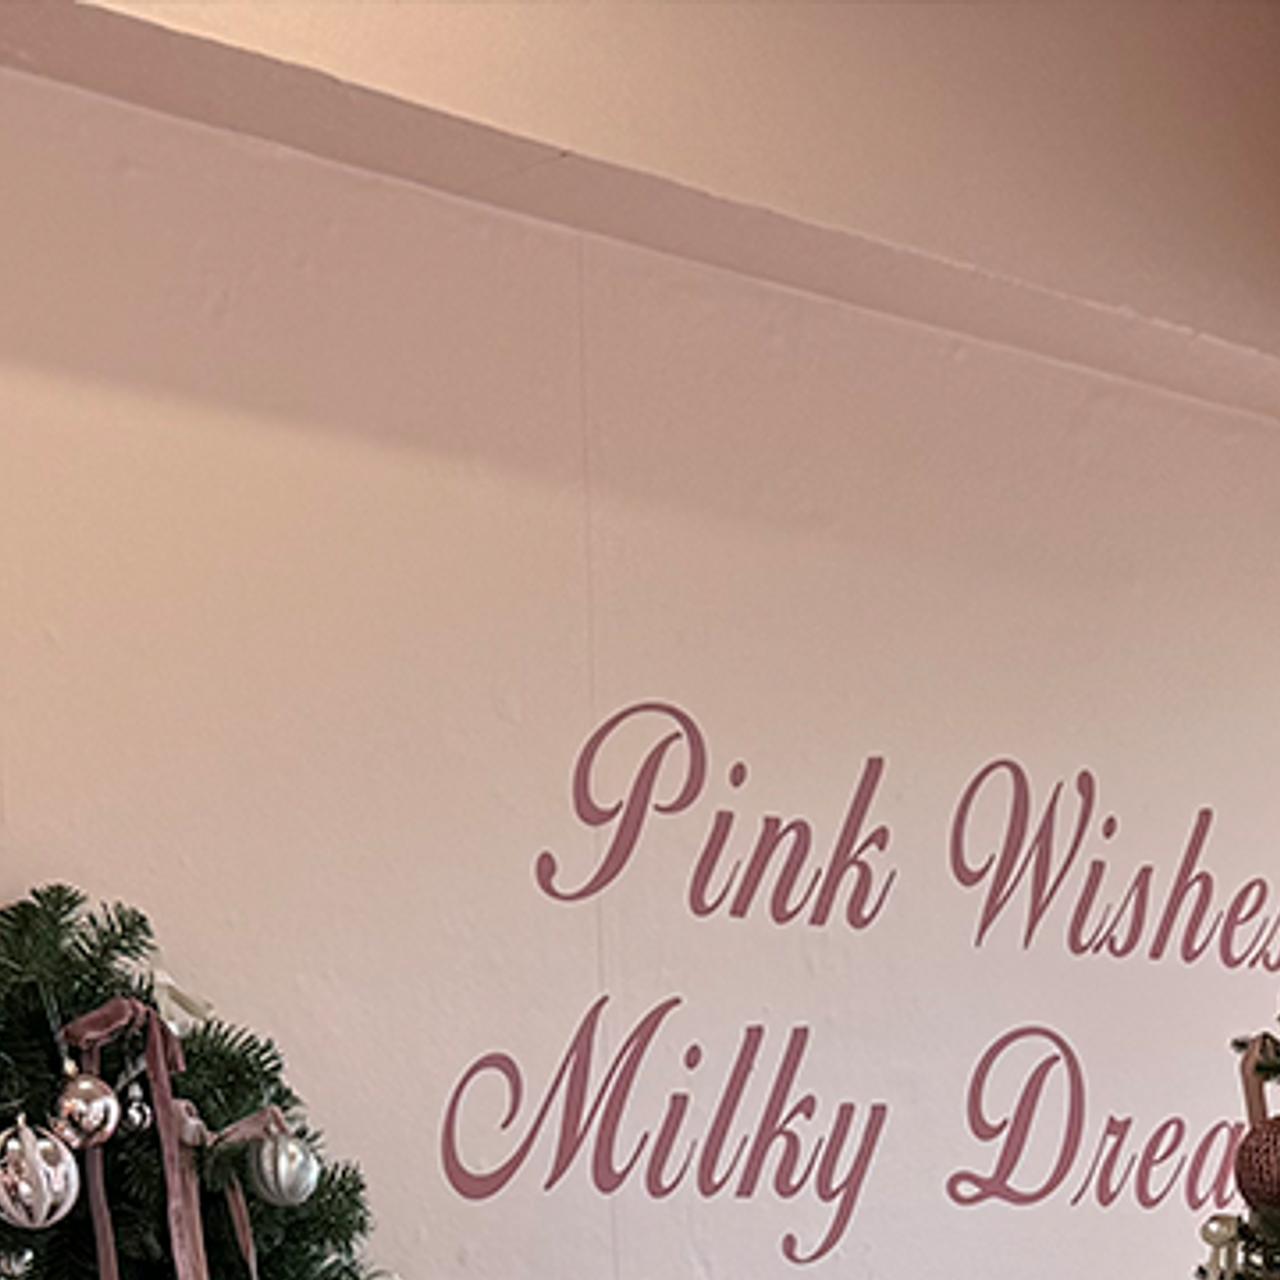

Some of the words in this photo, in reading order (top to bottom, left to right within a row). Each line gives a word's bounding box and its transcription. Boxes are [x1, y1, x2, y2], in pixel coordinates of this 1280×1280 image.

[534, 701, 896, 929] Pink
[440, 994, 888, 1265] Milky
[947, 1025, 1249, 1210] Drea
